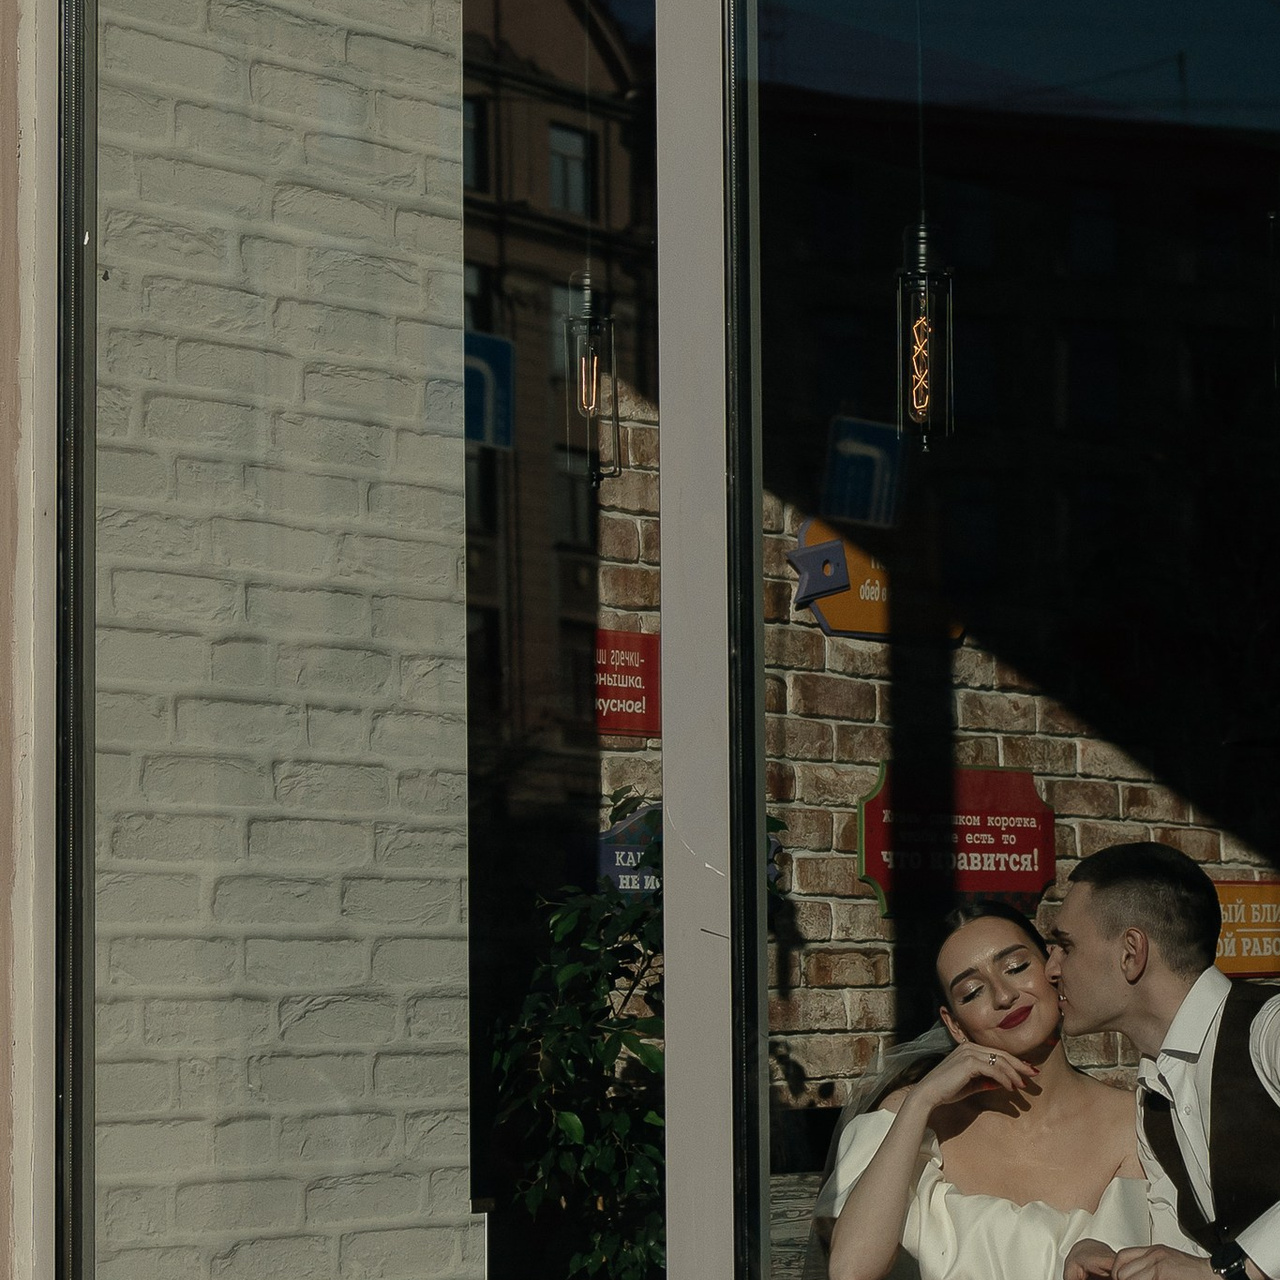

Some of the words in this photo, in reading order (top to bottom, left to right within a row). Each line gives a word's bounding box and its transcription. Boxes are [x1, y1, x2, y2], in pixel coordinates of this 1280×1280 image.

[859, 578, 880, 602] обед
[965, 832, 995, 844] есть
[1002, 833, 1017, 844] то
[618, 874, 640, 890] НЕ
